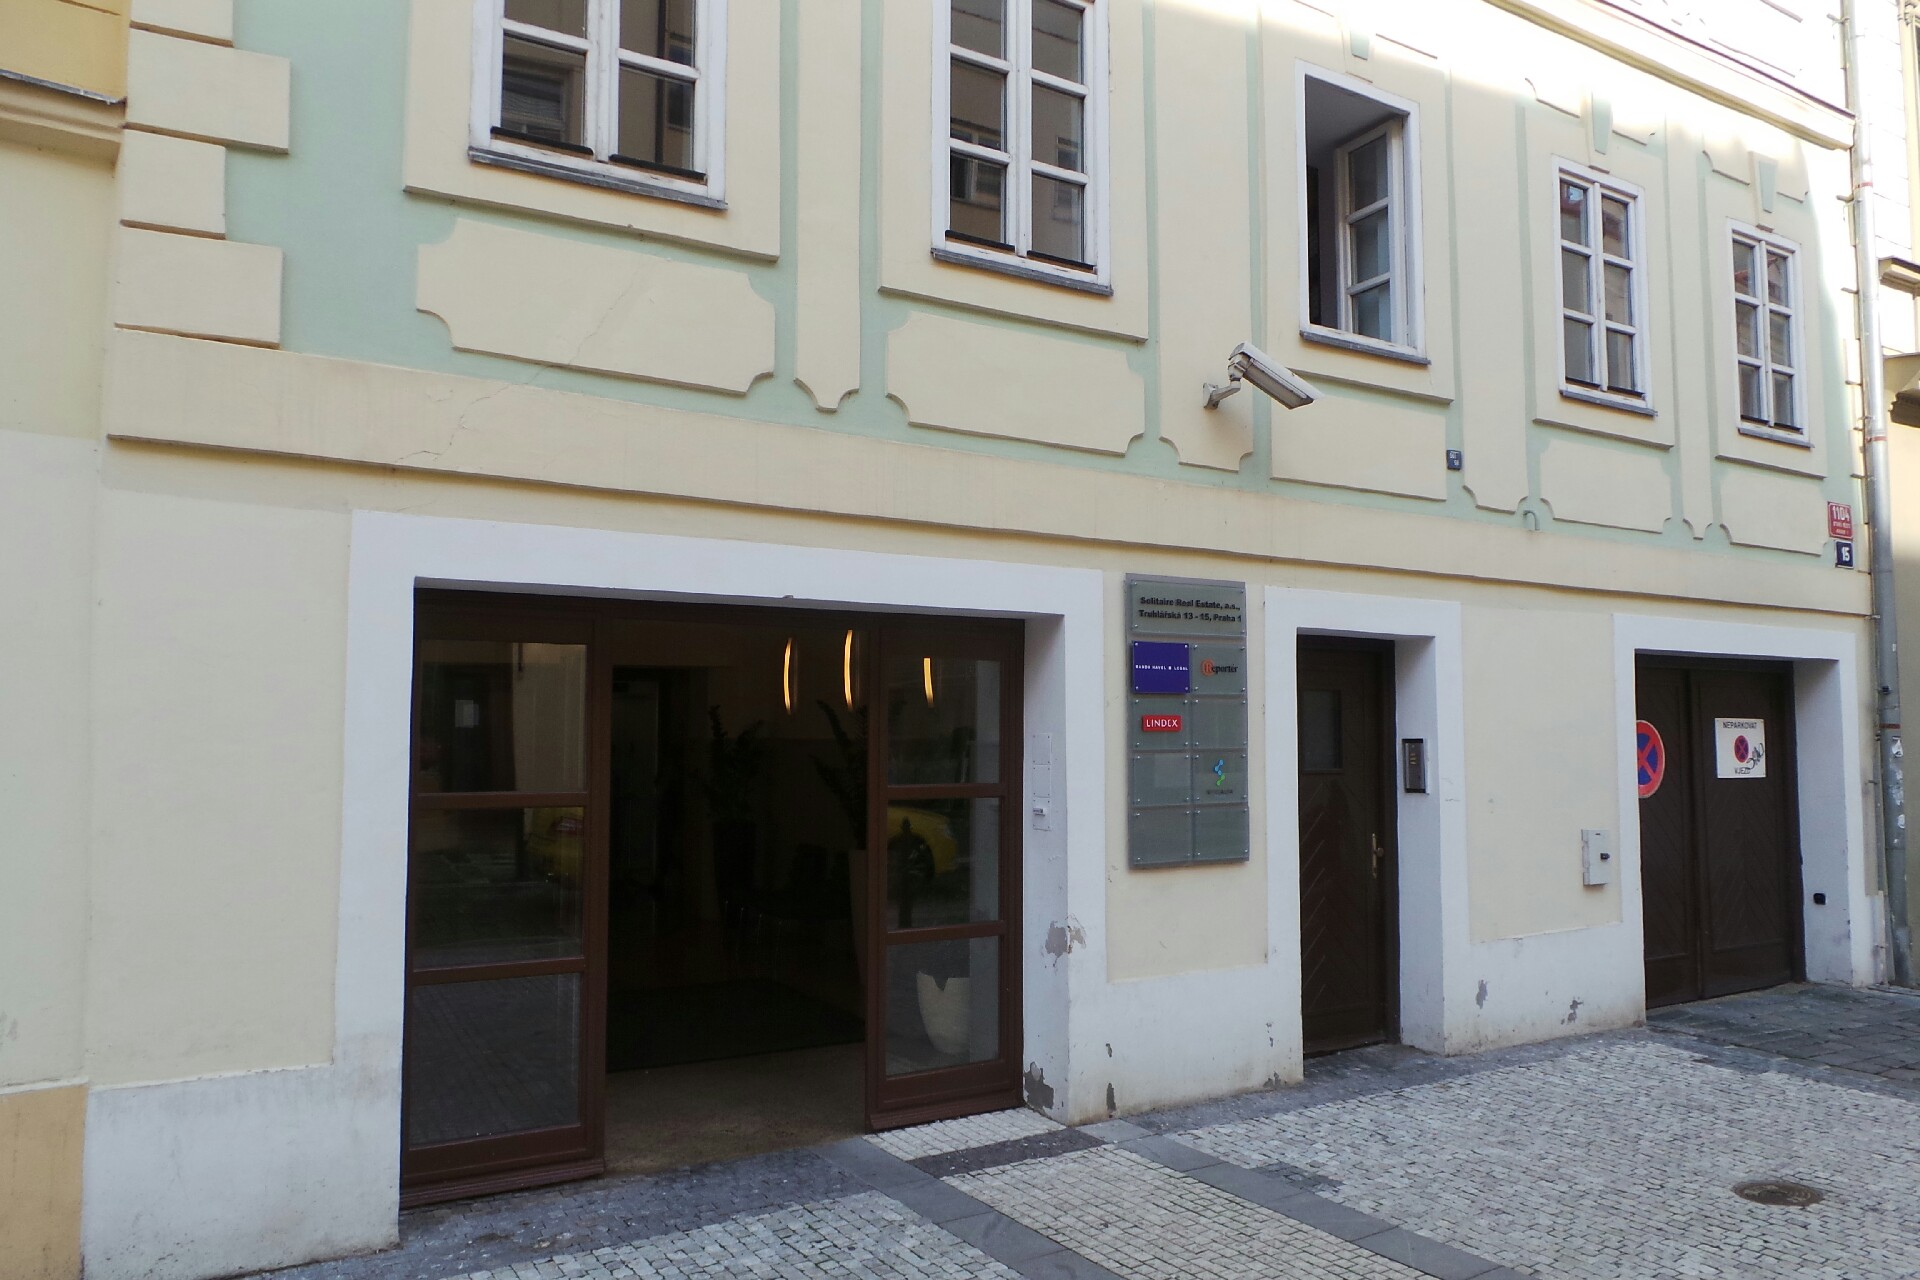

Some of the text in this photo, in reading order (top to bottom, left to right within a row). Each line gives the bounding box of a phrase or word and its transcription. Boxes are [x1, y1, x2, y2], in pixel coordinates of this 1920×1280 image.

[1832, 505, 1850, 522] 1104
[1841, 546, 1850, 562] 15
[1140, 596, 1174, 606] Solitaire
[1175, 599, 1194, 607] Real
[1195, 599, 1223, 610] Estate,
[1184, 612, 1194, 620] 13
[1201, 613, 1212, 622] 15,
[1213, 613, 1236, 623] Praha
[1146, 719, 1179, 728] LINDEX
[1722, 721, 1758, 729] NEPARKOVAT
